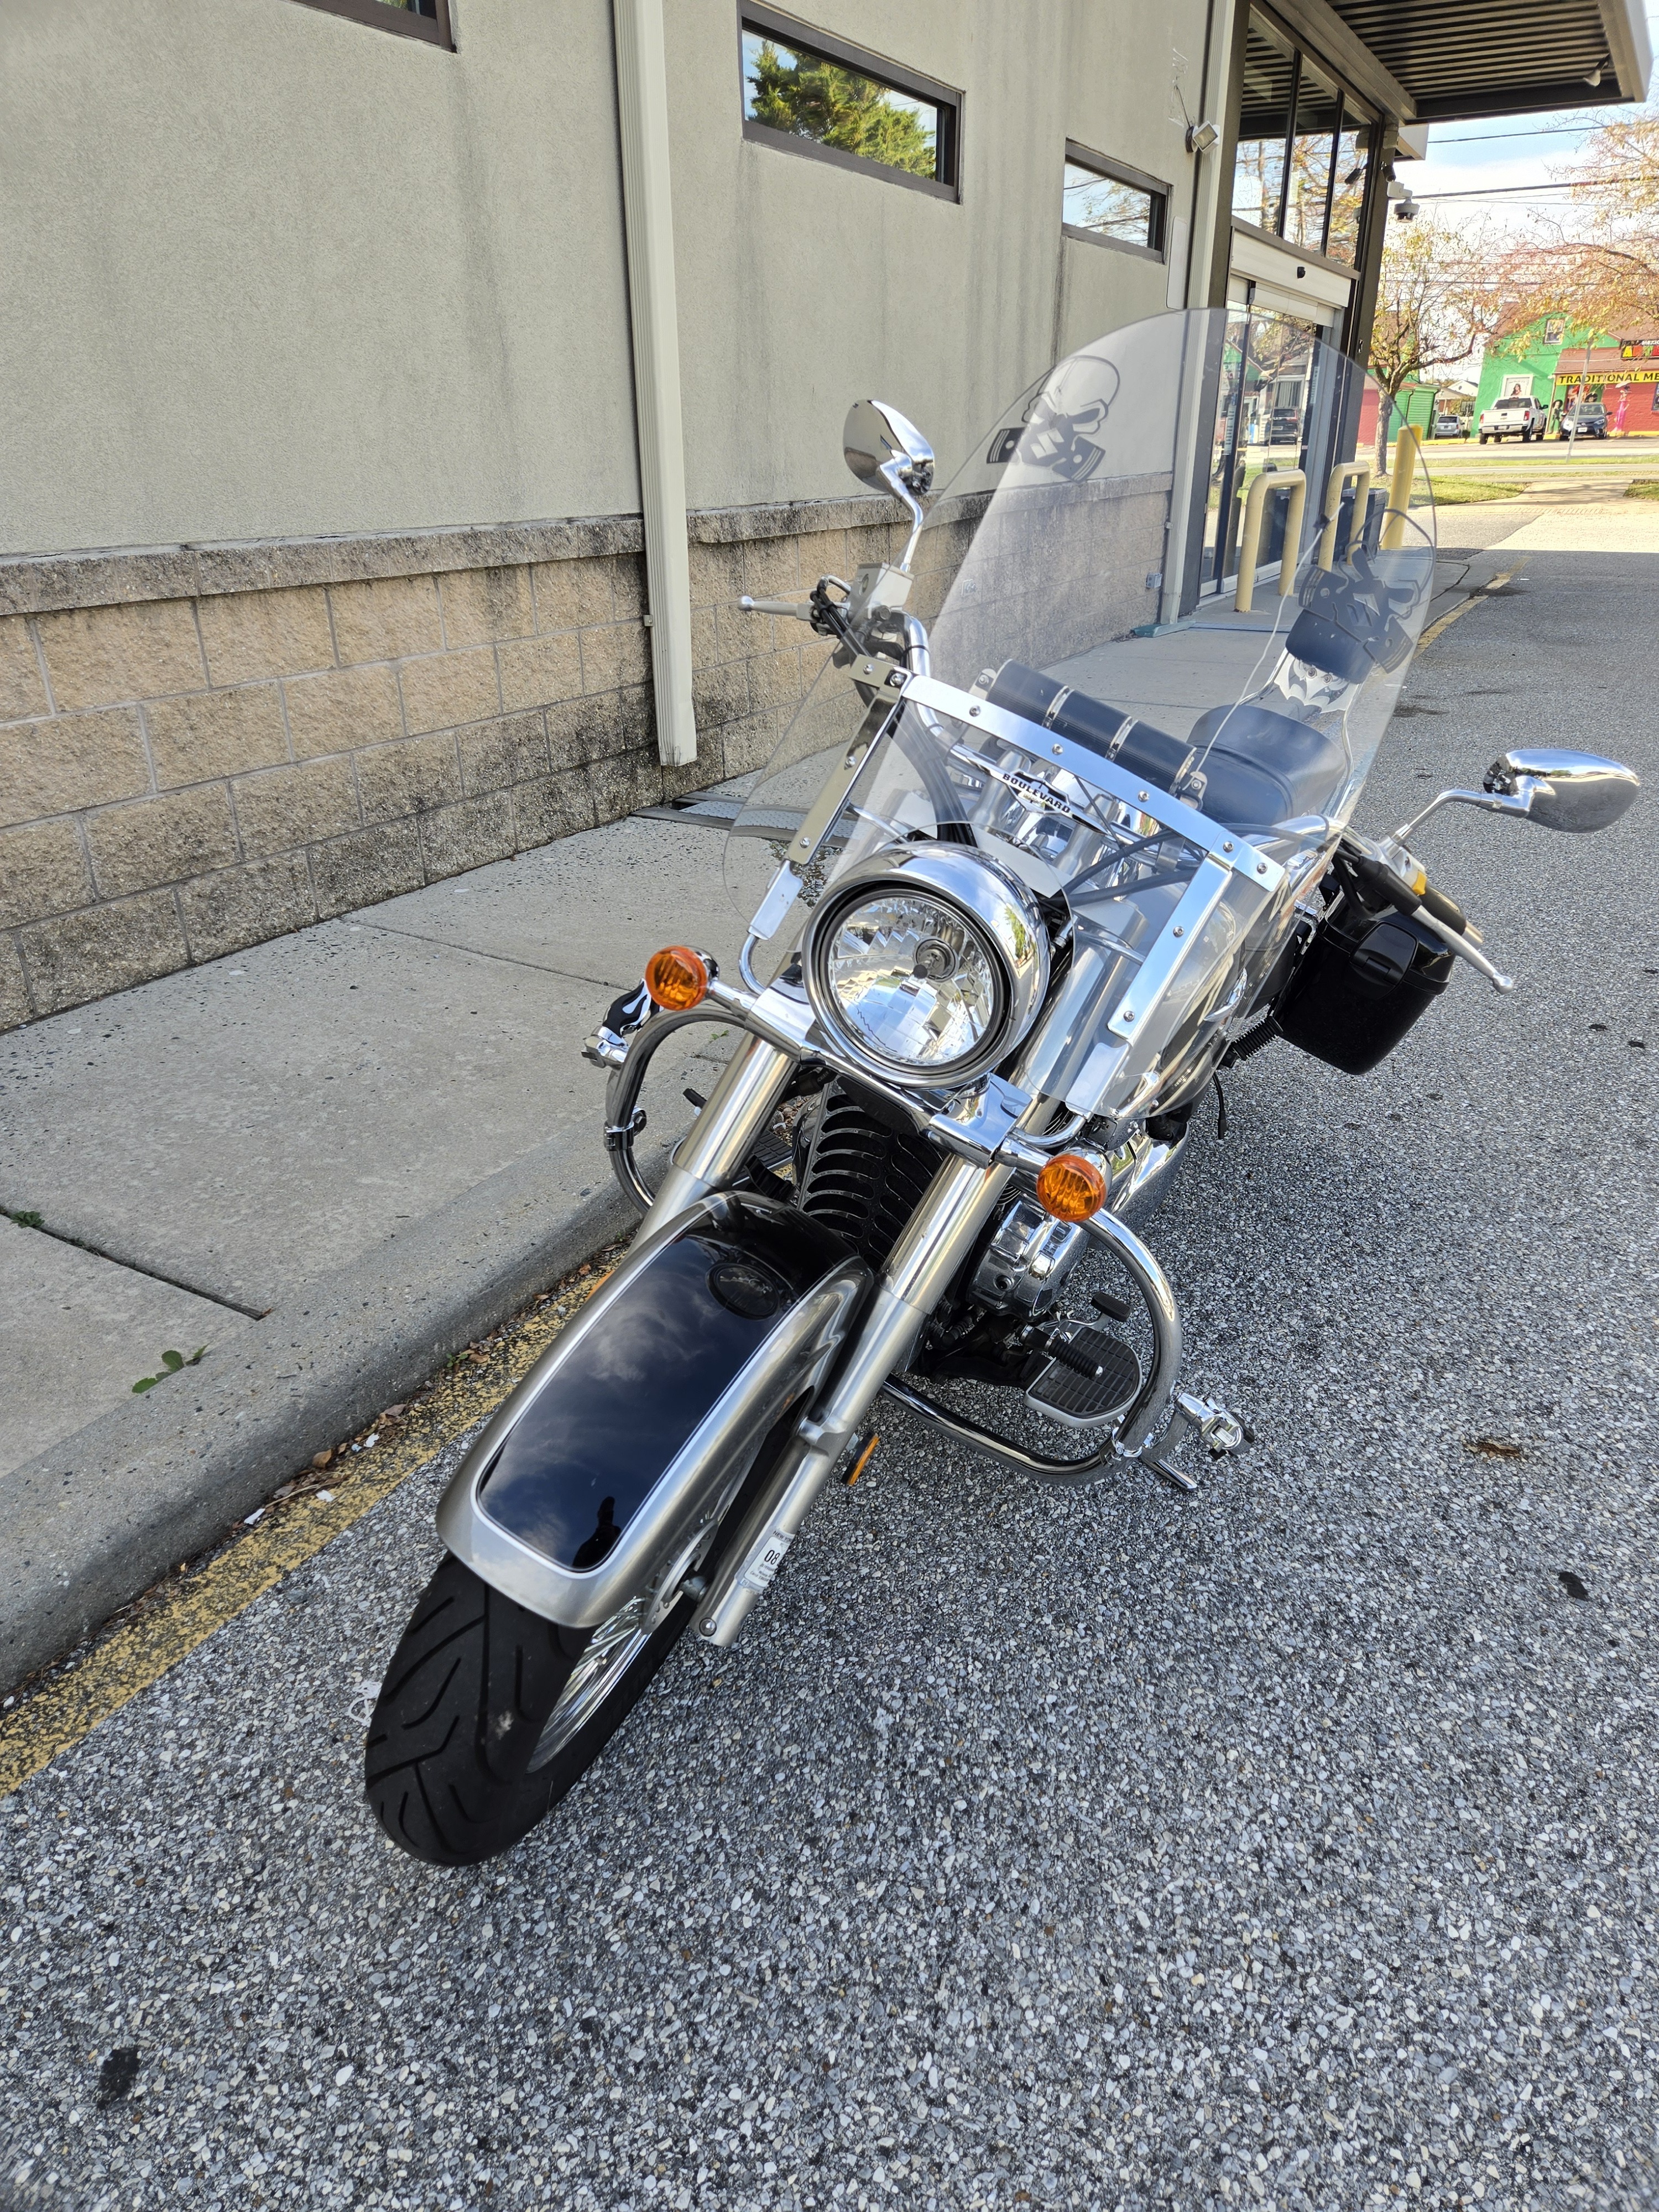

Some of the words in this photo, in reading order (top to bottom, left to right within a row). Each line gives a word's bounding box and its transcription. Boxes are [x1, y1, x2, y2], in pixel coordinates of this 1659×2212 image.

[1559, 373, 1639, 383] TRADITIONAL
[1002, 774, 1071, 813] BOULEVARD
[773, 1530, 785, 1539] NEW
[764, 1550, 780, 1564] 08
